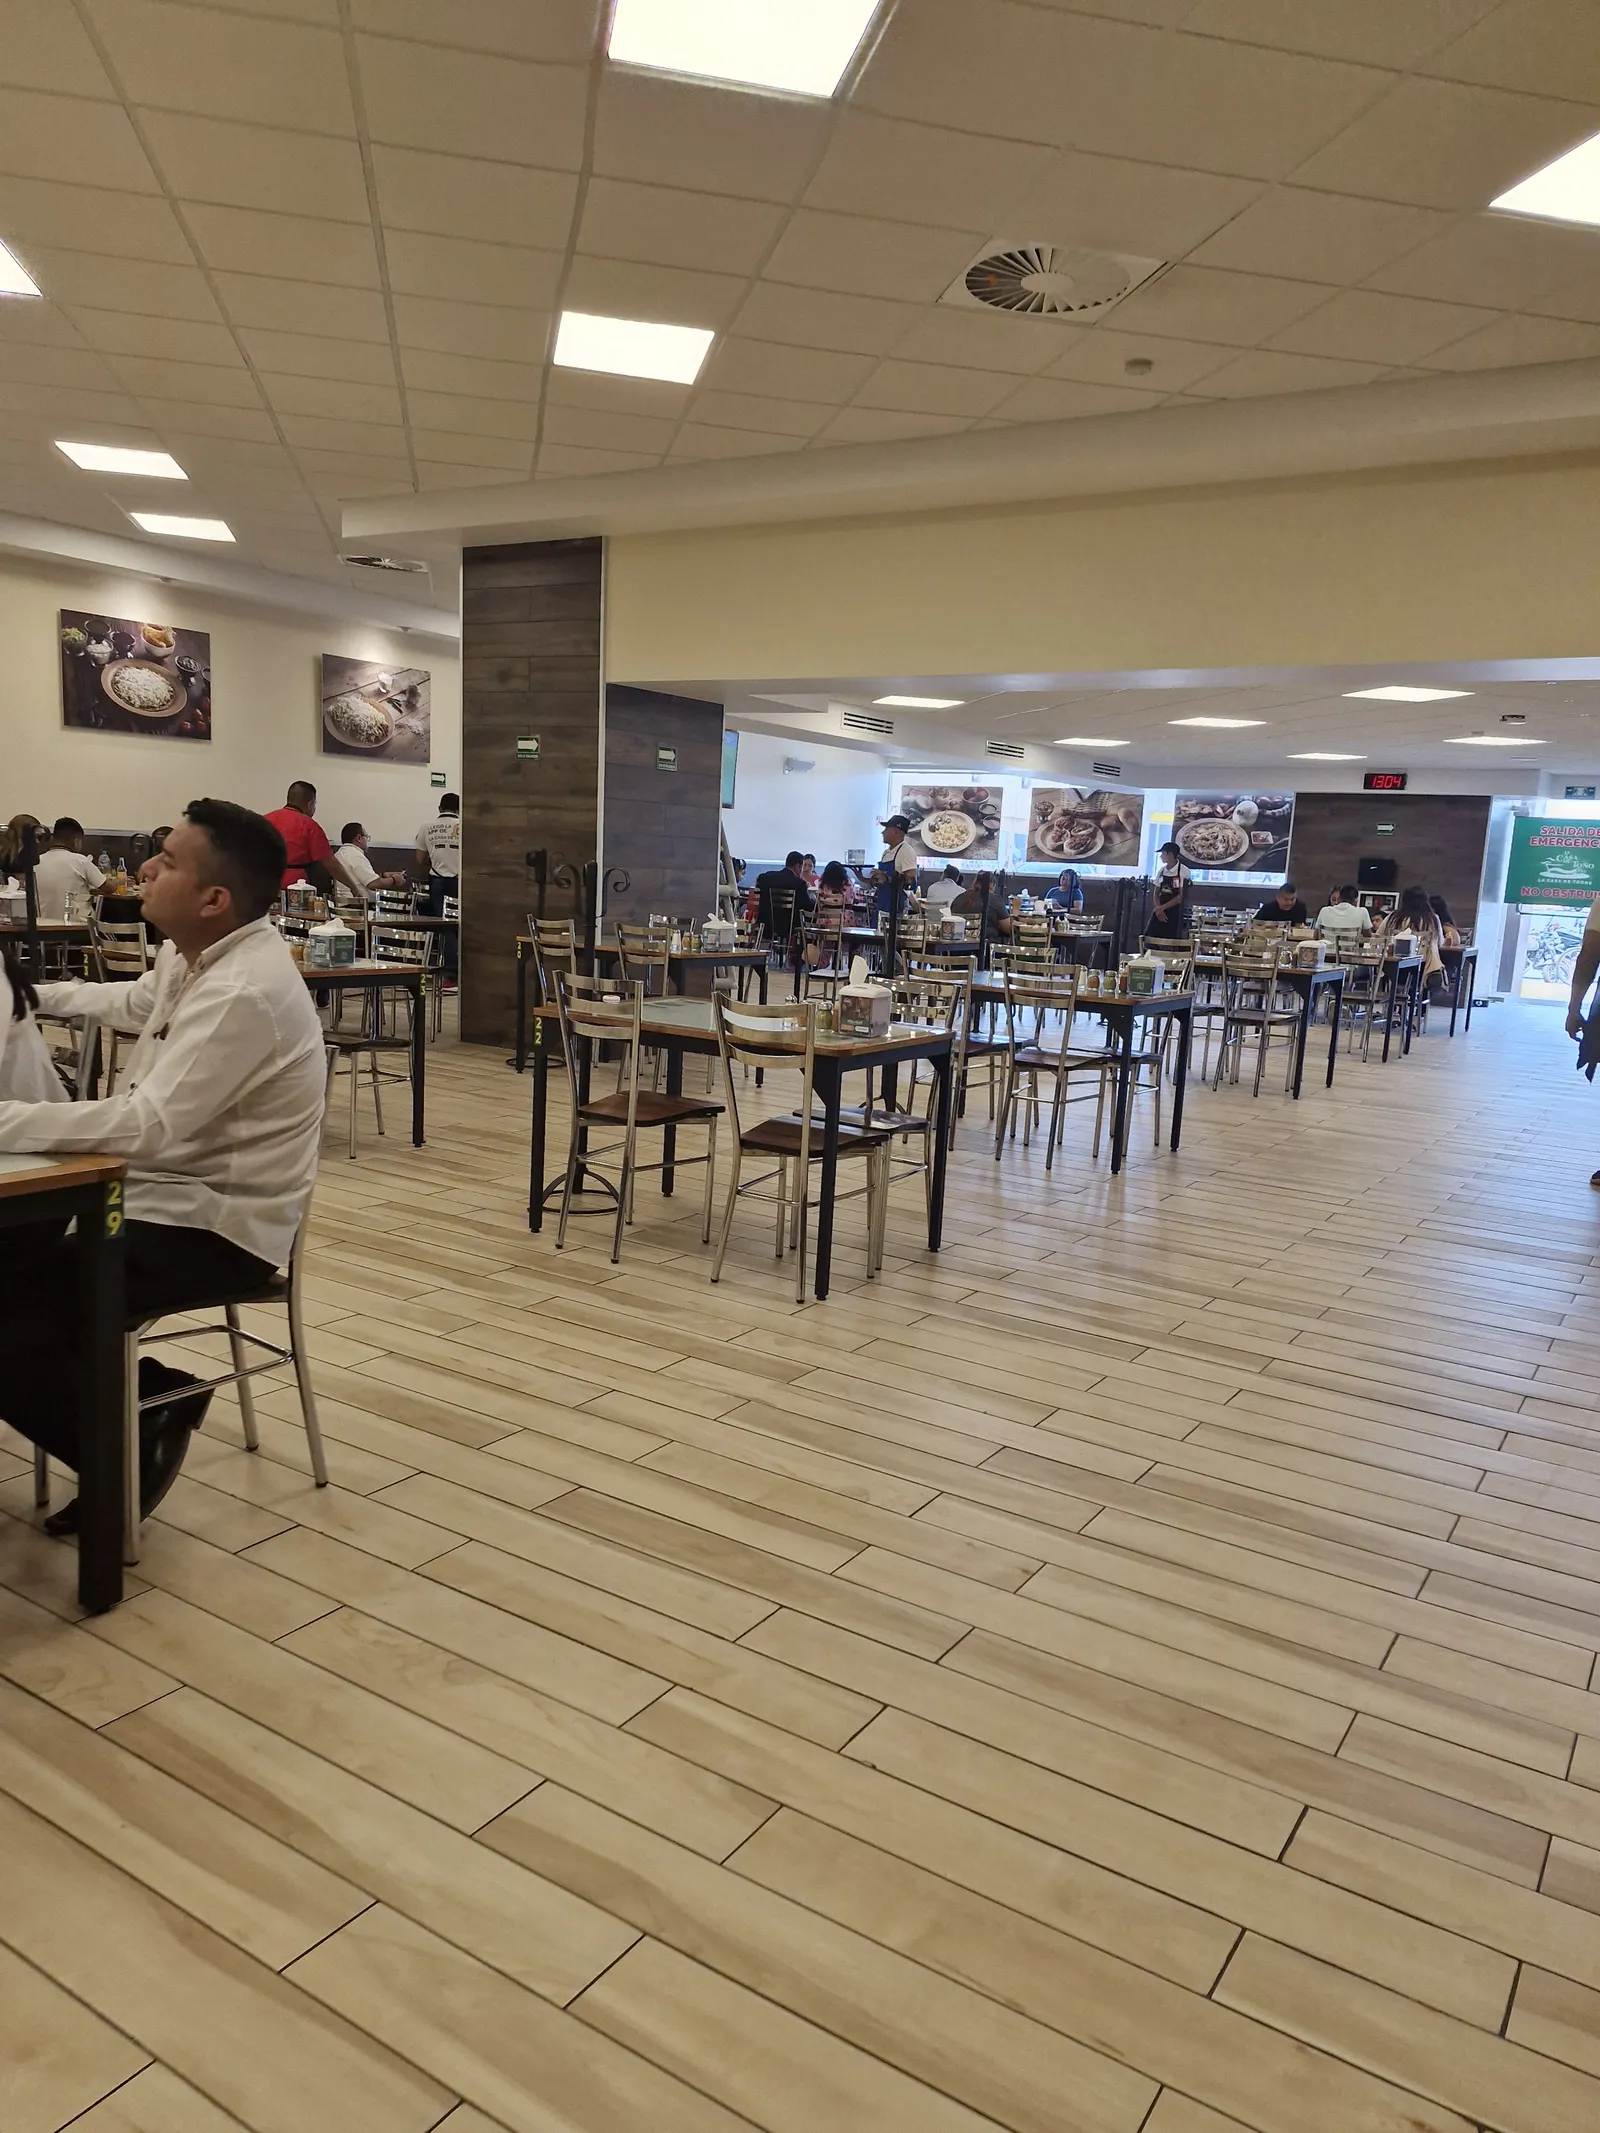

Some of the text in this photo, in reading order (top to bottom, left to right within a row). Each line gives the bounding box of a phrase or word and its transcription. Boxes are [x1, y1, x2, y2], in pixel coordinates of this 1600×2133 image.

[1540, 826, 1600, 838] SALIDA DE
[1530, 837, 1600, 848] EMERGENC
[1556, 854, 1578, 862] CASA
[1521, 887, 1540, 896] NO
[535, 1016, 542, 1045] 22
[107, 1181, 122, 1236] 29
